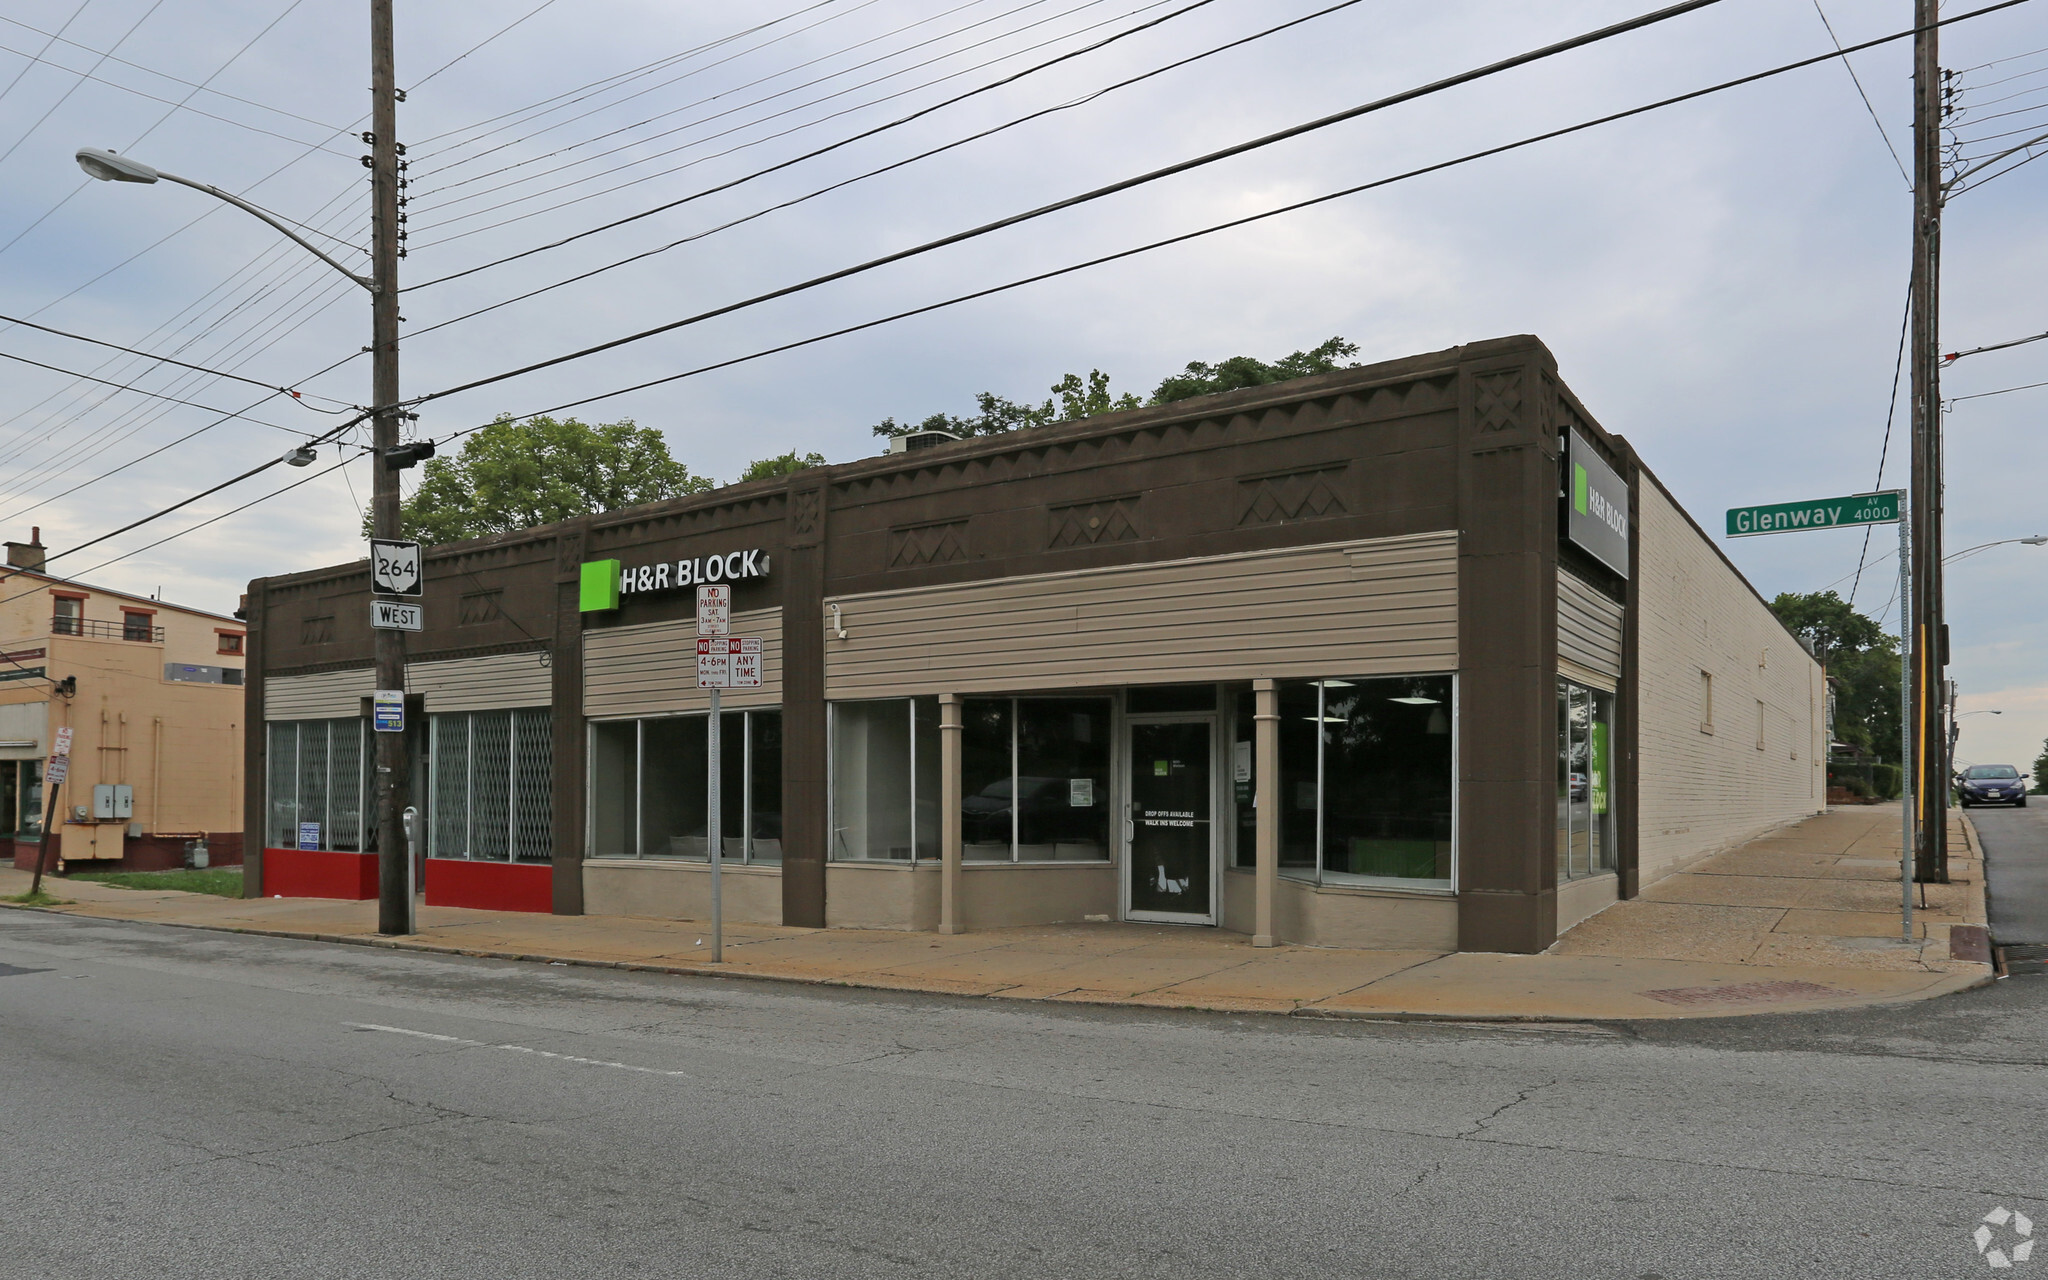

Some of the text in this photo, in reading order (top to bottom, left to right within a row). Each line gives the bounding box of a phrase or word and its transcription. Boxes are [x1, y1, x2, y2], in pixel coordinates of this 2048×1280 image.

[1867, 497, 1879, 506] AV
[1589, 486, 1627, 540] H&R BLOCK
[1854, 506, 1890, 520] 4000
[1736, 506, 1842, 532] Glenway
[378, 558, 415, 577] 264
[622, 549, 760, 594] H&R BLOCK
[707, 588, 720, 598] NO
[700, 599, 727, 608] PARKING
[380, 606, 415, 625] WEST
[698, 642, 708, 652] NO
[730, 641, 740, 651] NO
[736, 656, 755, 665] ANY
[735, 668, 756, 677] TIME
[388, 720, 402, 728] 513
